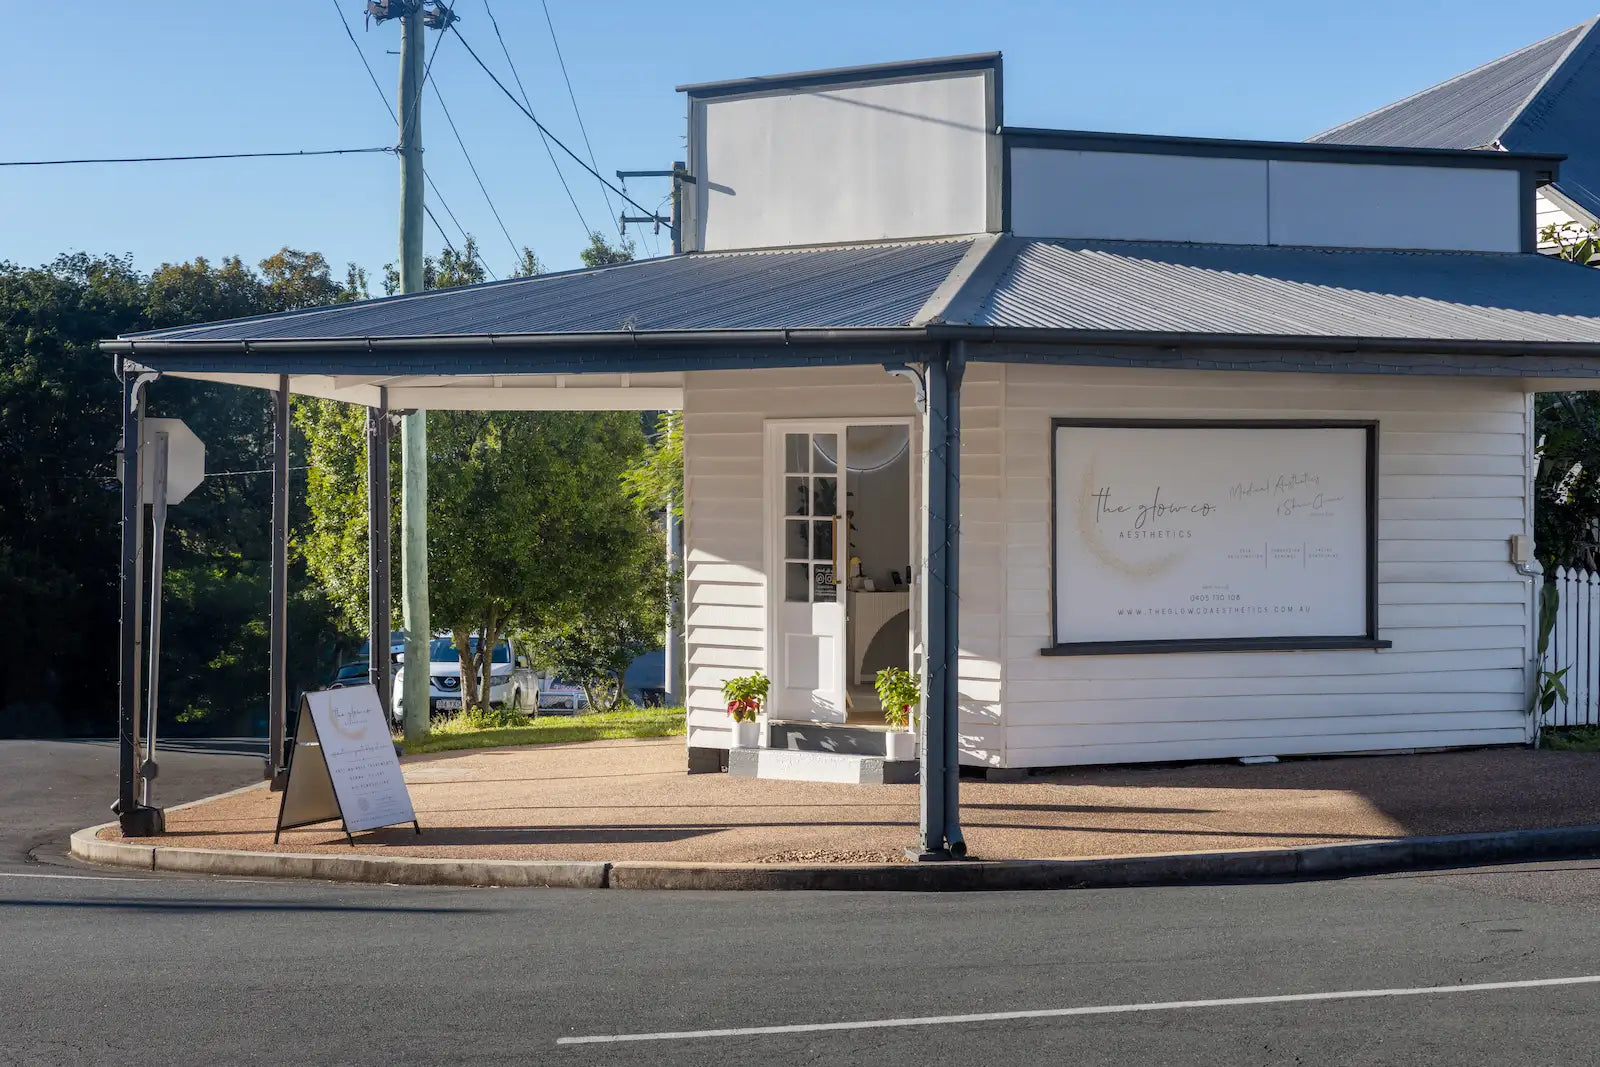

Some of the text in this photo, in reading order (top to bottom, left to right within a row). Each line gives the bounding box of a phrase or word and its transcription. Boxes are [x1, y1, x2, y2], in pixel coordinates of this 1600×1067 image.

[1091, 486, 1216, 529] the glow co.
[1119, 530, 1192, 539] AESTHETICS
